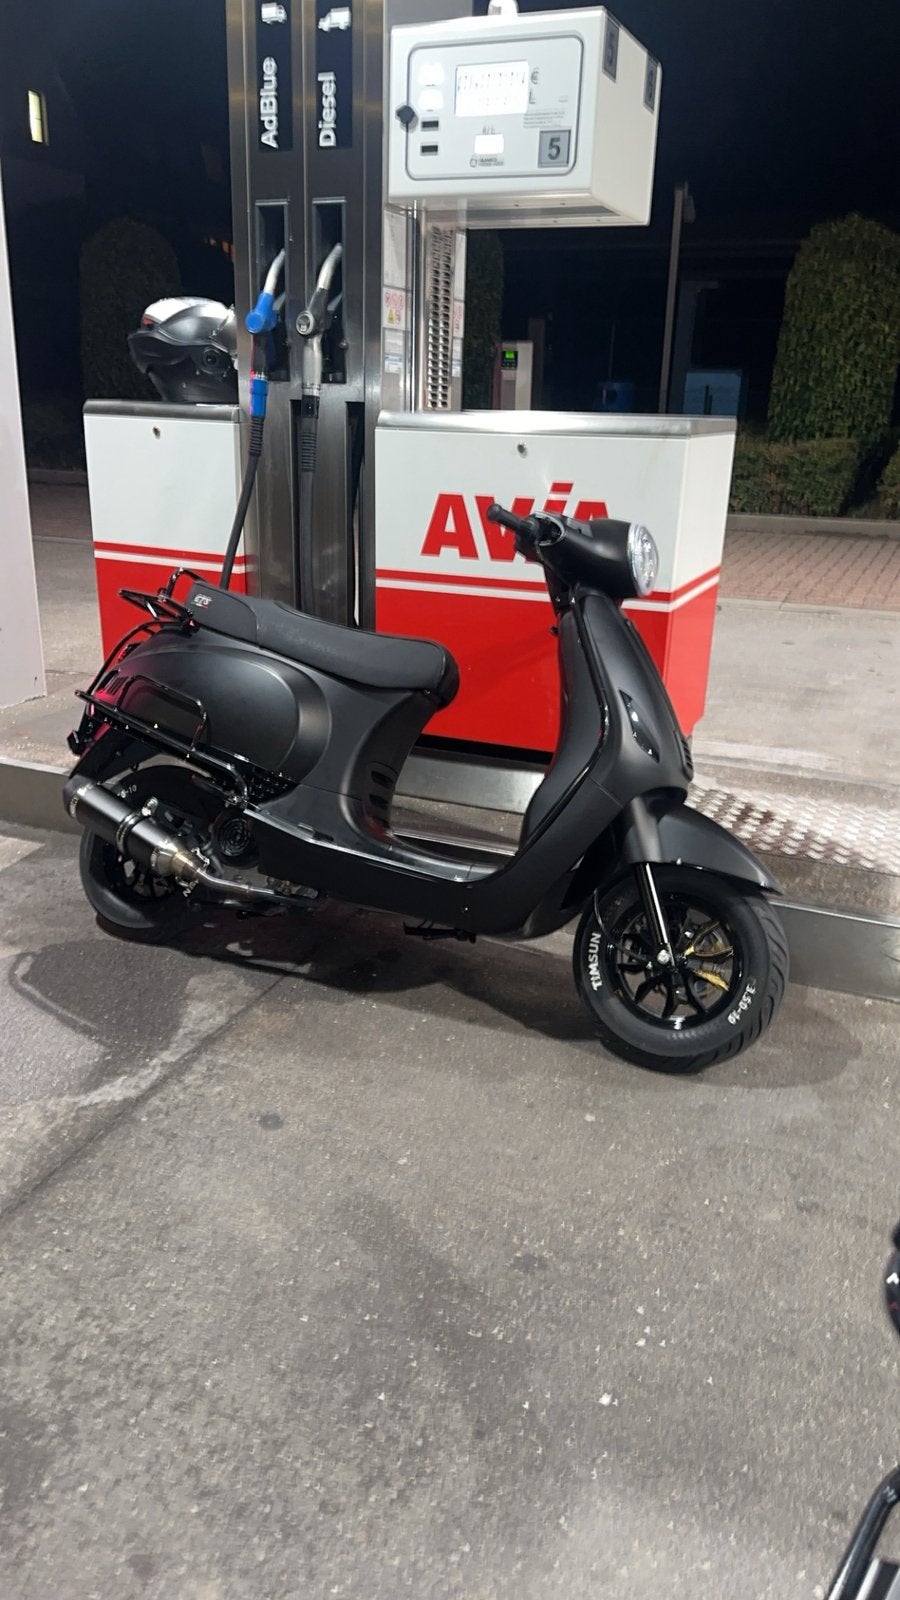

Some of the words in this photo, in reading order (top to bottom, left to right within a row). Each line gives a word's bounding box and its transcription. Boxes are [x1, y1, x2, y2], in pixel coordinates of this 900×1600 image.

[260, 56, 279, 149] AdBlue
[317, 71, 336, 147] Diesel
[547, 137, 561, 161] 5
[420, 481, 609, 563] AV
[588, 932, 603, 991] TIMSUN
